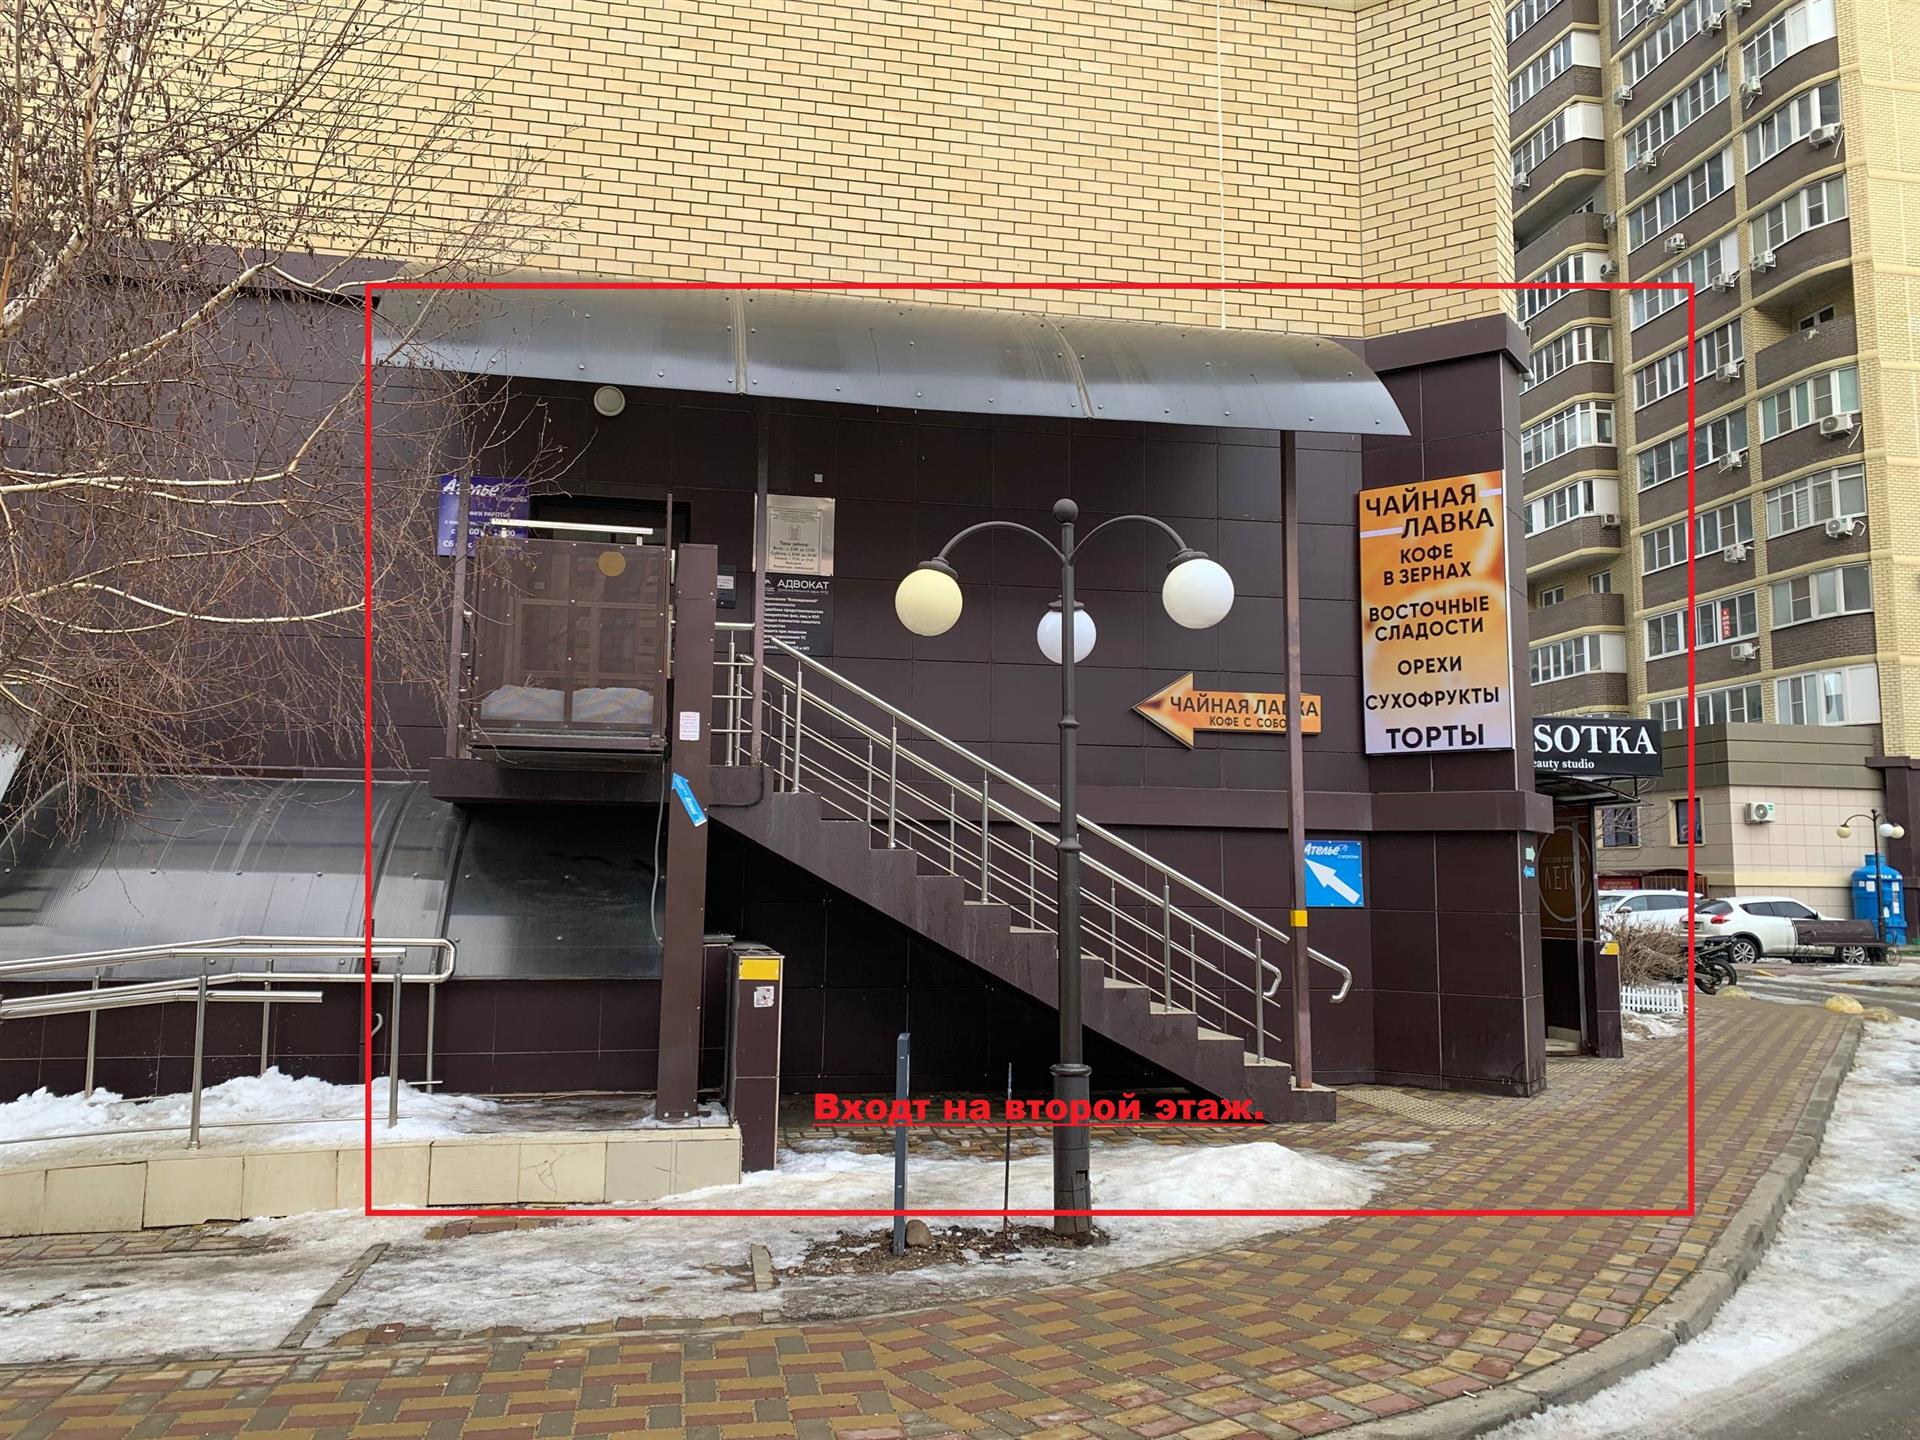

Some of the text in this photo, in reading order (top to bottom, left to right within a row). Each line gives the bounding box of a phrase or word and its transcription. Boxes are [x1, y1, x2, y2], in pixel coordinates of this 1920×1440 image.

[1366, 483, 1476, 517] ЧАЙНАЯ
[1401, 508, 1494, 539] ЛАВКА
[1400, 543, 1453, 564] КОФЕ
[777, 580, 830, 590] АДВОКАТ
[1384, 561, 1471, 586] В ЗЕРНАХ
[1369, 596, 1489, 622] ВОСТОЧНЫЕ
[1375, 617, 1483, 641] СЛАДОСТИ
[1398, 656, 1462, 675] ОРЕХИ
[1170, 693, 1250, 715] ЧАЙНАЯ
[1365, 687, 1499, 710] СУХОФРУКТЫ
[1210, 716, 1287, 729] КОФЕ С СОБО
[1386, 724, 1484, 749] ТОРТЫ
[1533, 724, 1657, 754] SOTKA
[1533, 758, 1595, 771] eauty studio
[1304, 843, 1340, 856] Ателье
